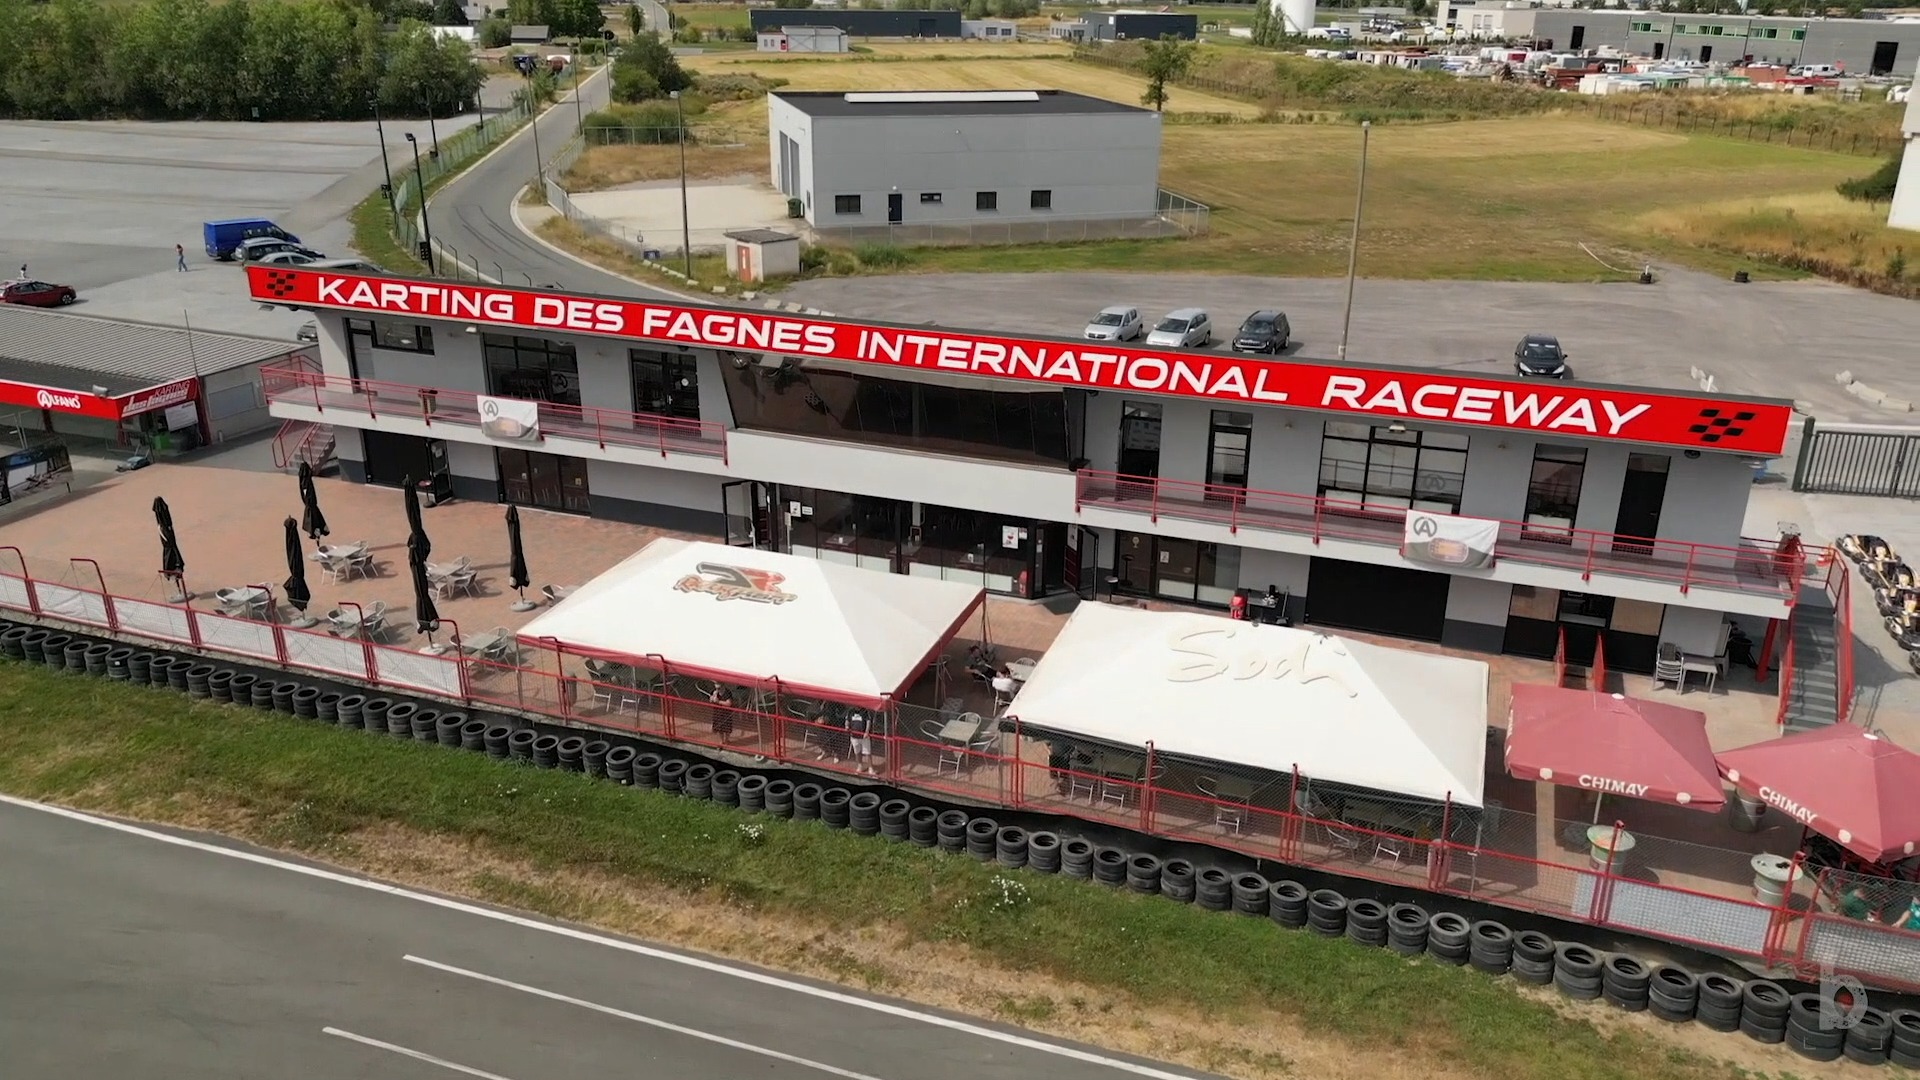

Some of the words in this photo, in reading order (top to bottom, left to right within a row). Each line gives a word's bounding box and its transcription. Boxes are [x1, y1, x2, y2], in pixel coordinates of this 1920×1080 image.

[317, 277, 515, 322] KARTING
[533, 297, 624, 332] DES
[642, 309, 836, 354] FAGNES
[857, 330, 1288, 402] INTERNATIONAL
[1321, 375, 1652, 436] RACEWAY
[154, 380, 190, 397] KARTING
[1578, 774, 1649, 796] CHIMAY
[1759, 786, 1818, 824] CHIMAY
